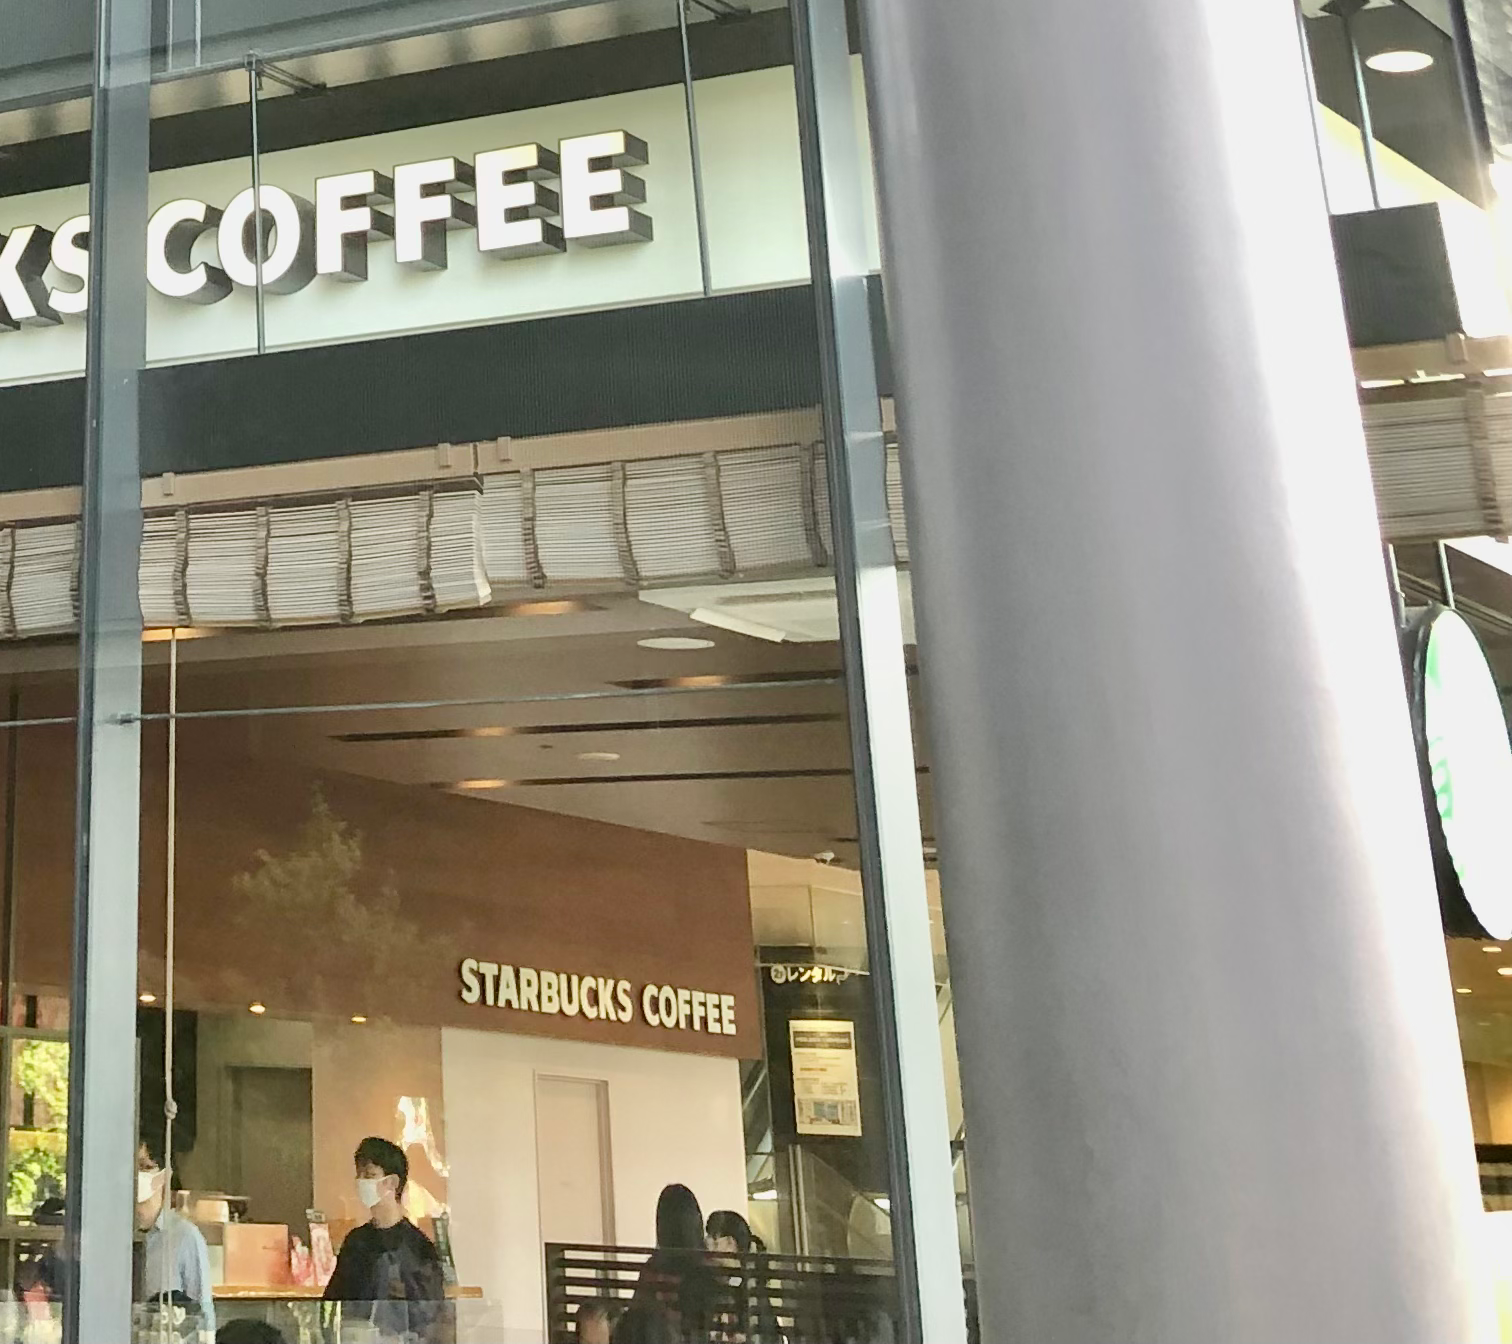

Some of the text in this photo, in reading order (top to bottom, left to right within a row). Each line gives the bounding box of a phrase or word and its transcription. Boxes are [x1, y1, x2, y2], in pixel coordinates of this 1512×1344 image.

[146, 129, 644, 300] COFFEE
[459, 957, 738, 1036] STARBUCKS COFFEE
